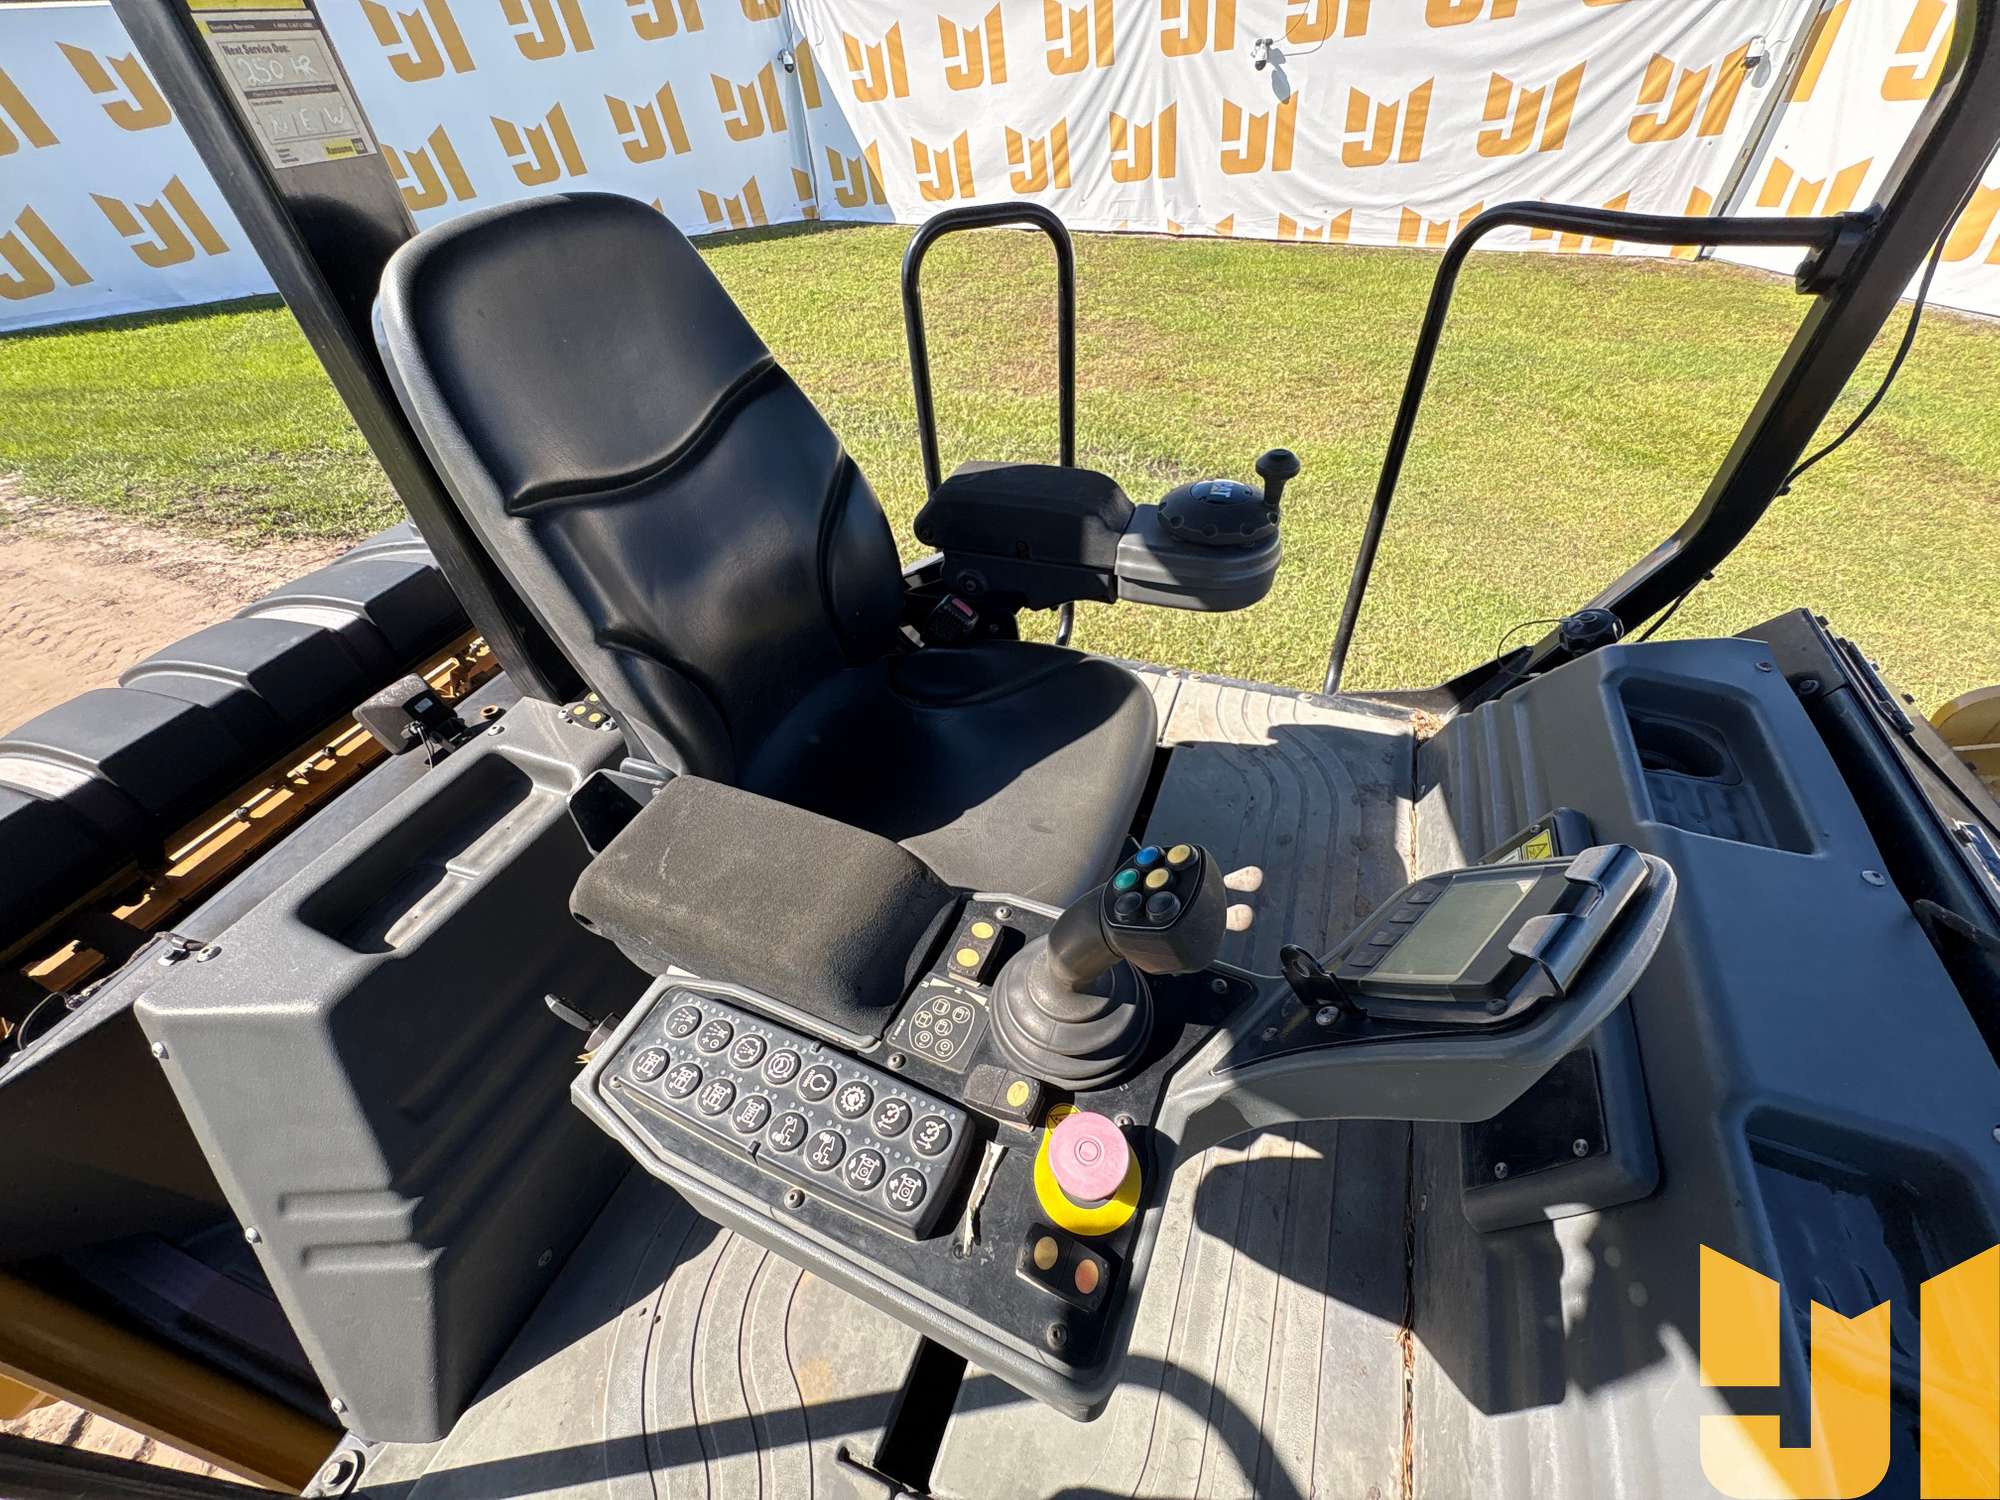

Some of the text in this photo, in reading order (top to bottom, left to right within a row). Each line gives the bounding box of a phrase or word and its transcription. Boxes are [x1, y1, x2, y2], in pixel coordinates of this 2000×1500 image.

[222, 44, 242, 56] Next
[242, 43, 272, 55] Service
[237, 58, 285, 86] 250
